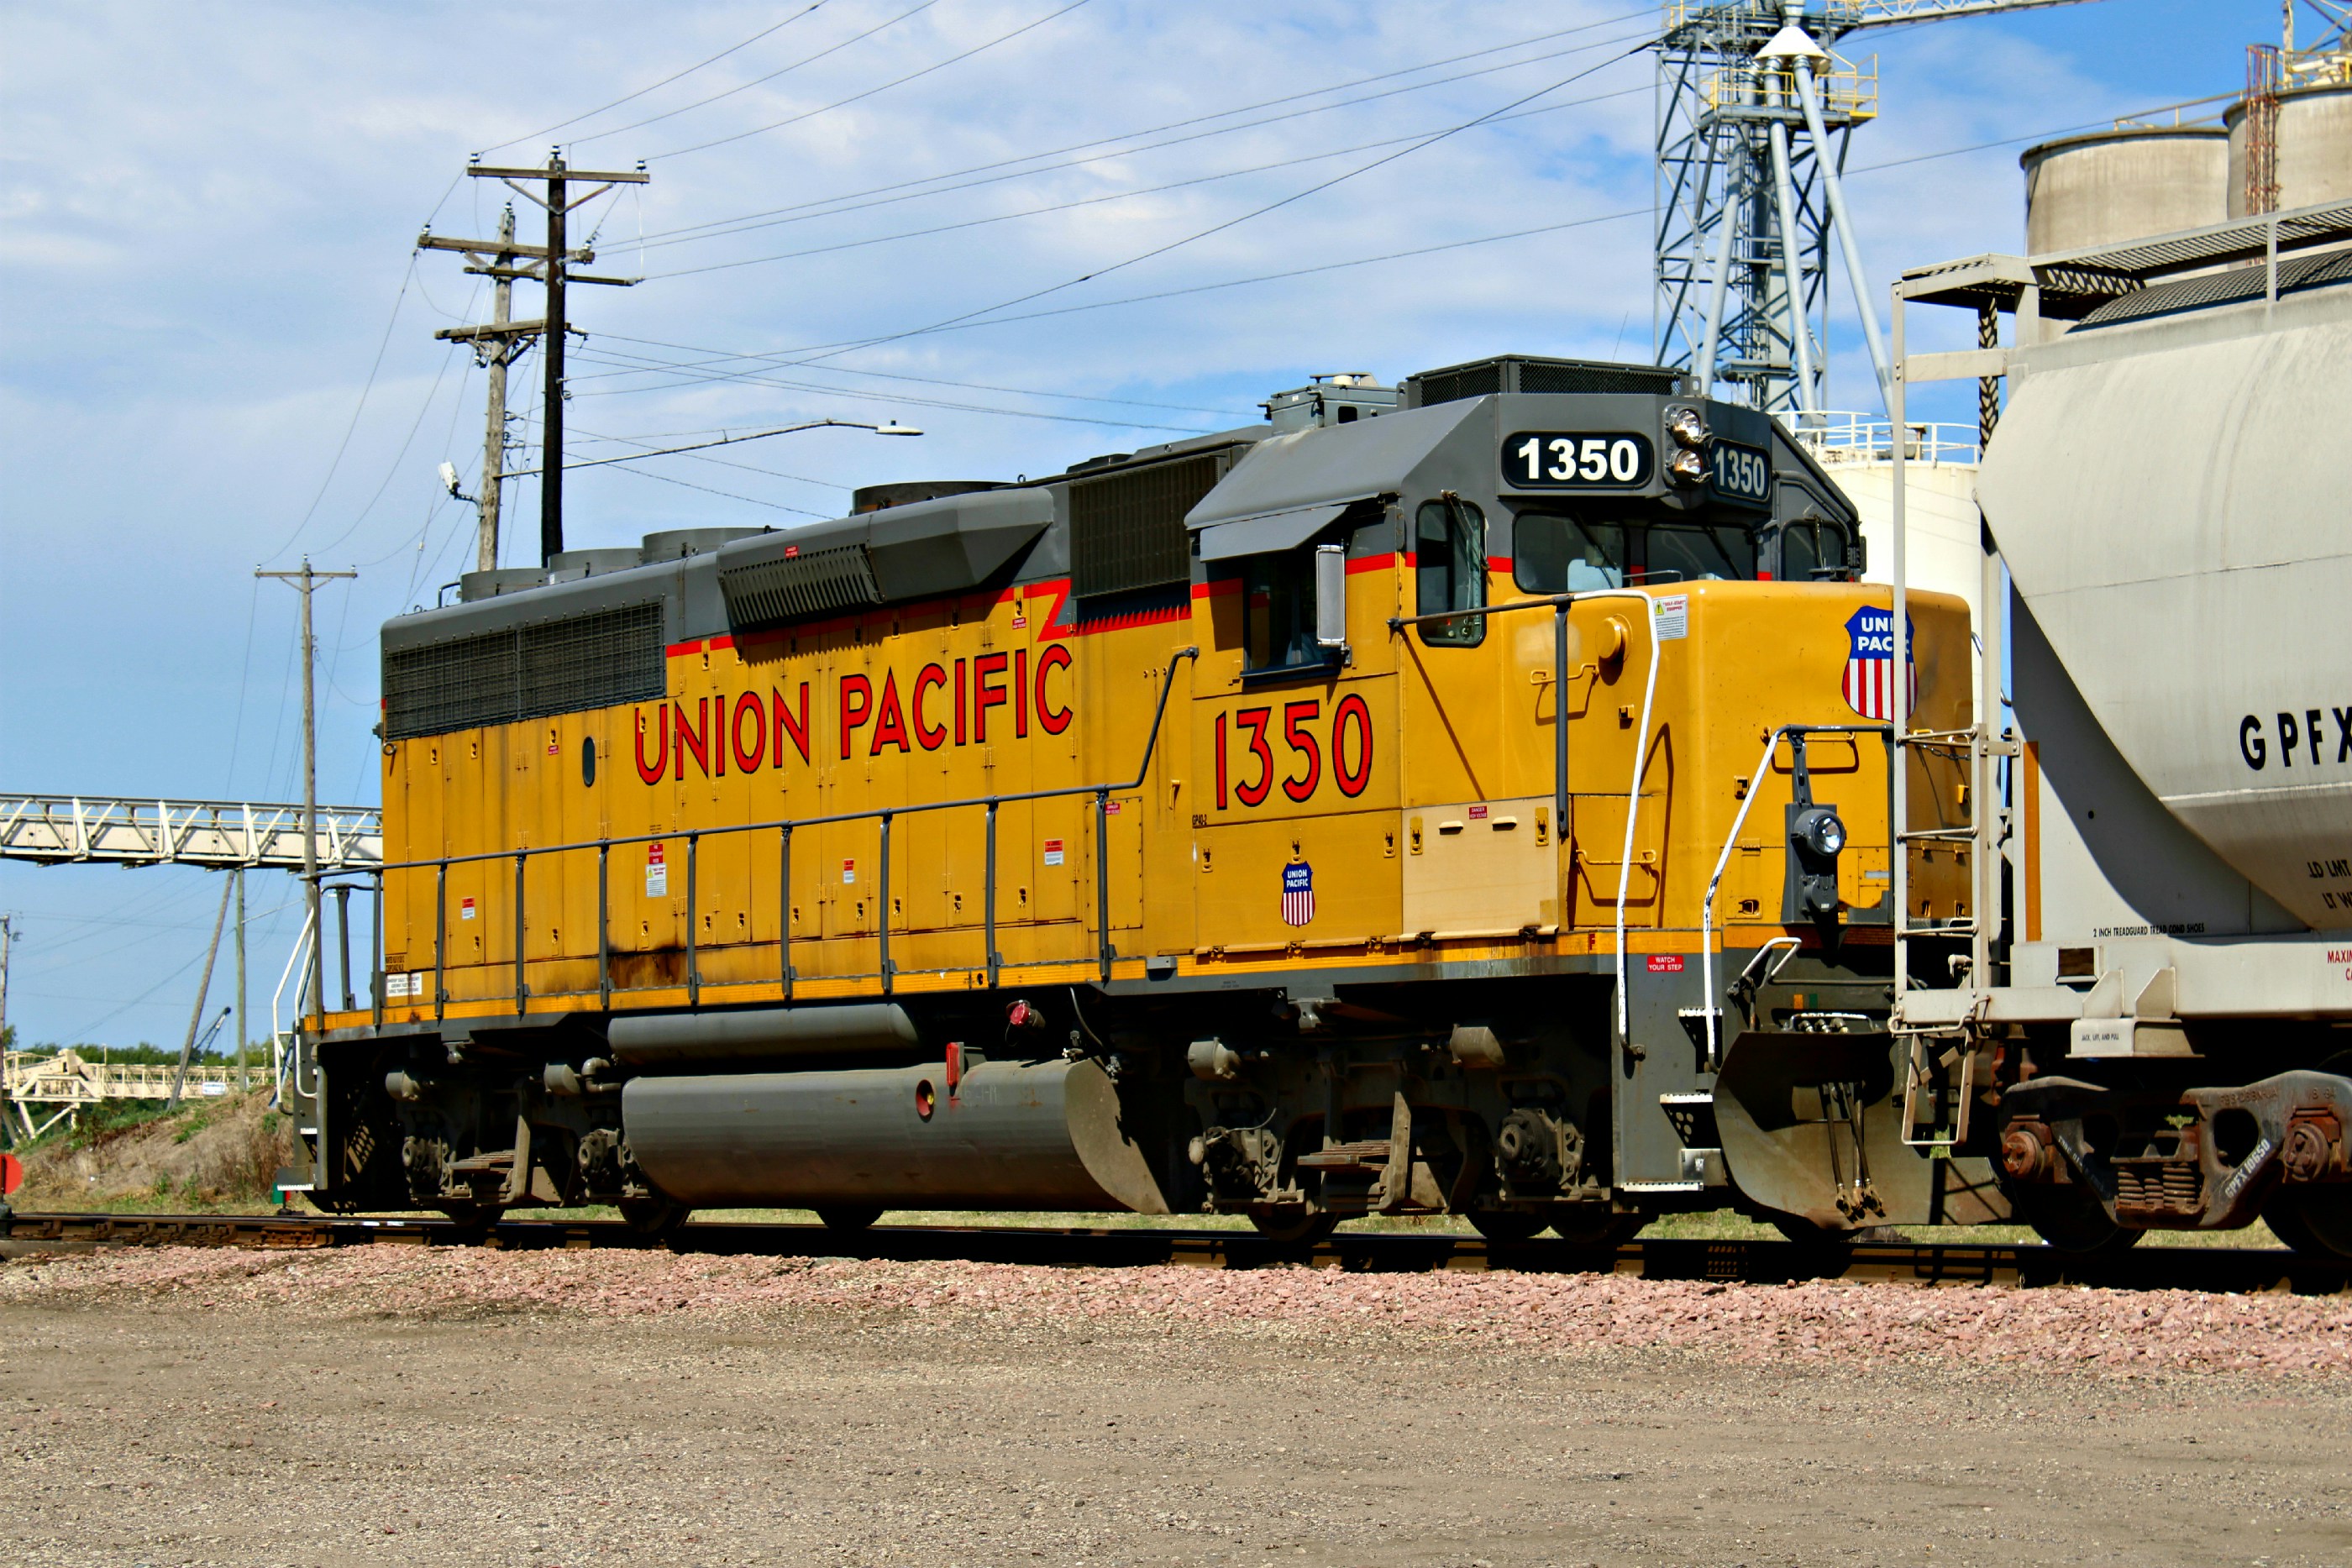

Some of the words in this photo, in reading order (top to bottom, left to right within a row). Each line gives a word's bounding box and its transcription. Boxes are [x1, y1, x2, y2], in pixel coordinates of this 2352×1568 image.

[1518, 438, 1639, 482] 1350
[1714, 447, 1765, 497] 1350
[634, 681, 810, 786] UNION
[840, 643, 1074, 760] PACIFIC
[2239, 706, 2352, 771] GPFX
[1215, 693, 1373, 810] 1350
[1192, 814, 1207, 826] GP40-2
[1287, 868, 1308, 878] UNION
[2325, 859, 2351, 878] LMT
[1286, 878, 1309, 888] PACIFIC
[2322, 892, 2338, 909] LT
[2092, 928, 2097, 937] 2
[2098, 927, 2112, 937] INCH
[2113, 926, 2148, 936] TREADGUARD
[2150, 924, 2167, 935] TREAD
[2168, 924, 2186, 934] COND
[2187, 922, 2205, 933] SHOES
[1588, 933, 1596, 951] F
[2345, 967, 2352, 981] C
[2224, 1168, 2248, 1198] GPFX
[2244, 1138, 2271, 1173] 10650
